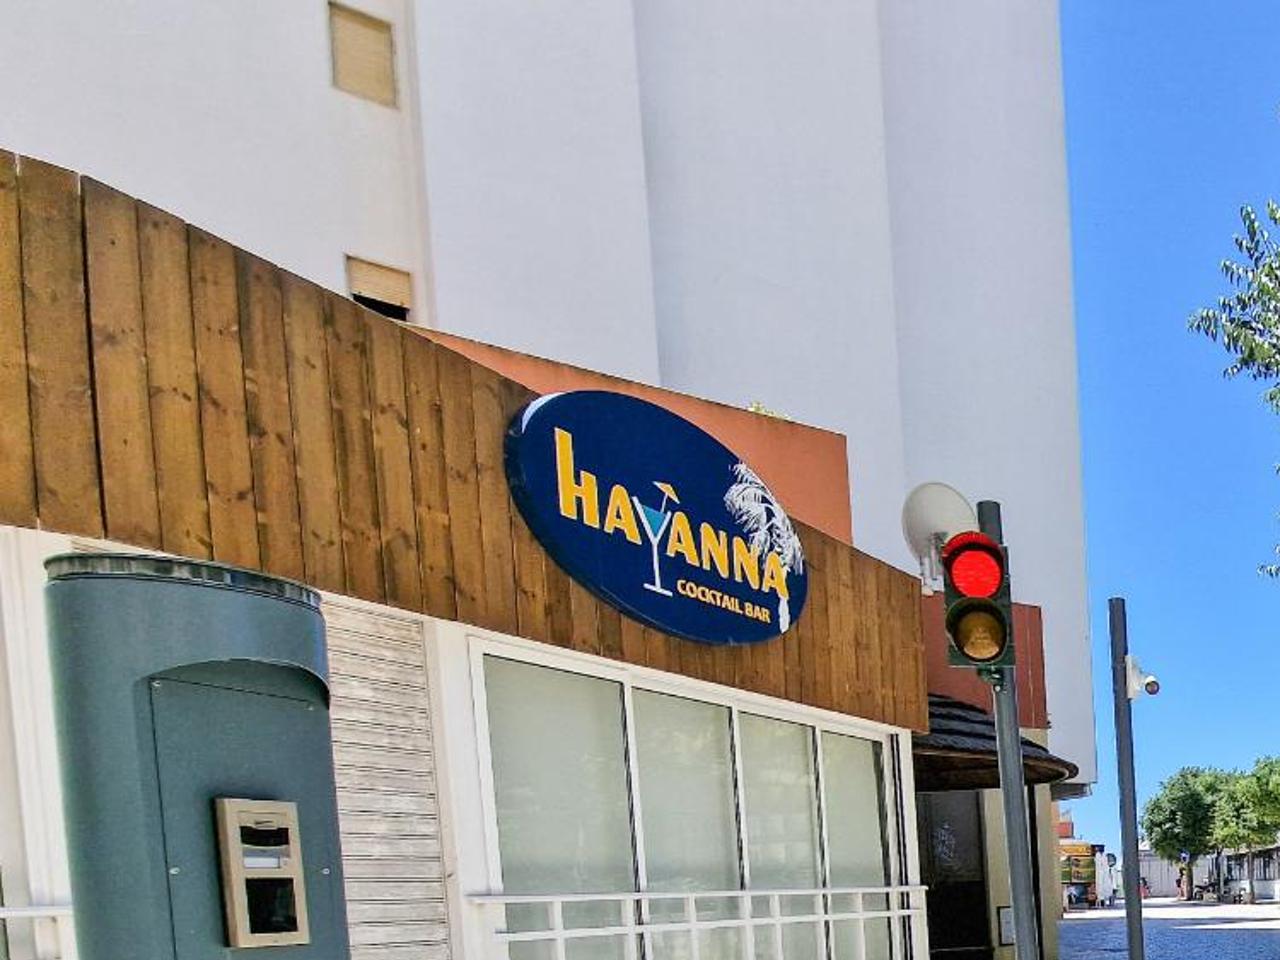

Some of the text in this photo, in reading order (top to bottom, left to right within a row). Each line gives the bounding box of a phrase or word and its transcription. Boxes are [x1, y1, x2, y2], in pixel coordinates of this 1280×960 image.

[554, 427, 789, 600] HAYANNA
[677, 579, 771, 623] COCKTAIL BAR
